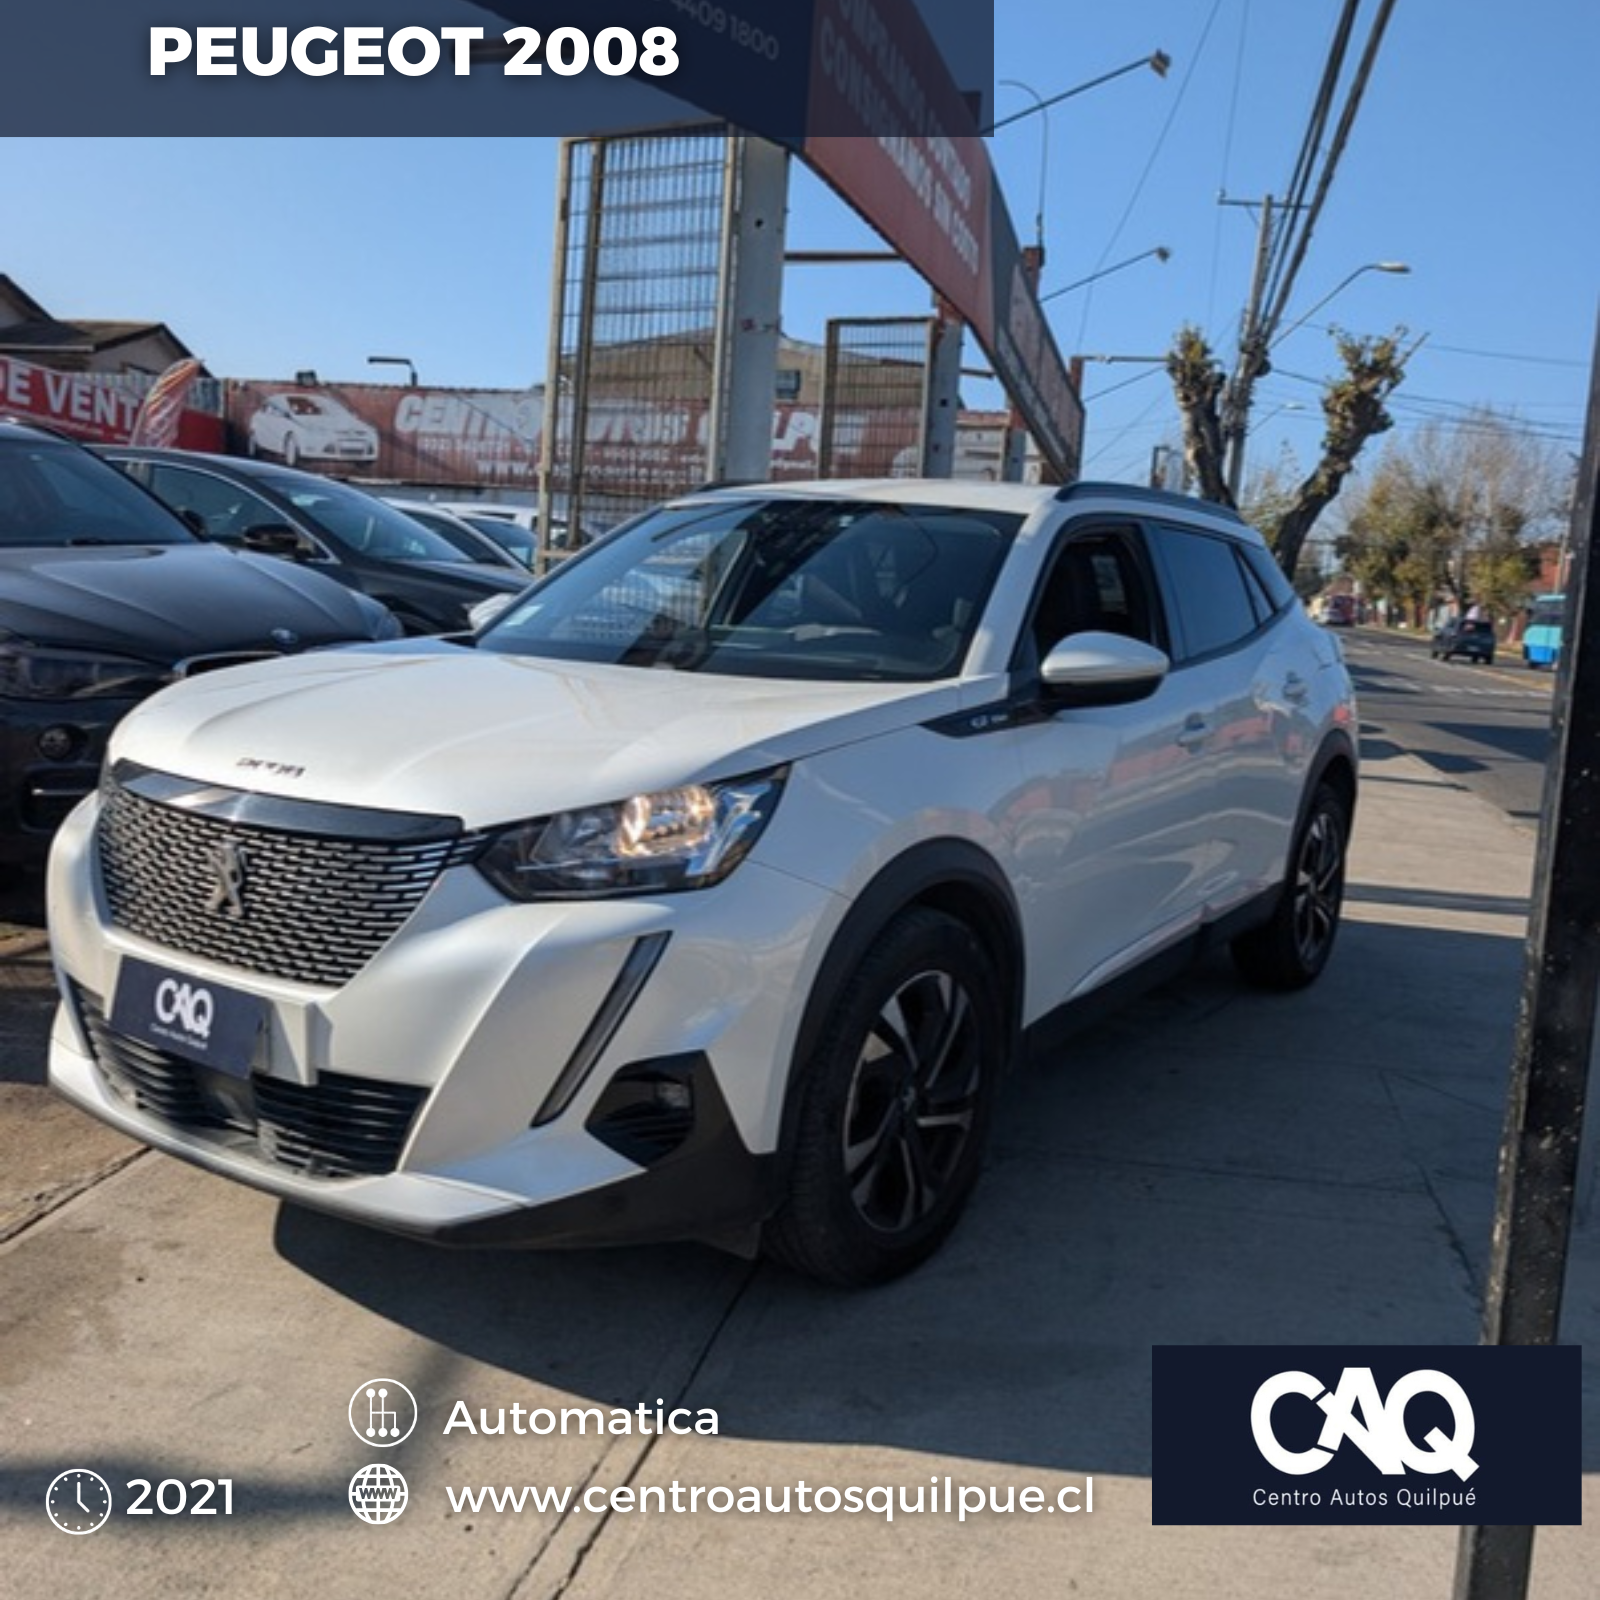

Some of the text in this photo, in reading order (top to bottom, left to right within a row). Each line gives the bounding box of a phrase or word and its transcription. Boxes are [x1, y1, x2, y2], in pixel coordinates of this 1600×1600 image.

[830, 0, 926, 137] MPRAMOS
[0, 360, 31, 405] E
[43, 372, 140, 431] VENT
[155, 977, 213, 1039] CAQ
